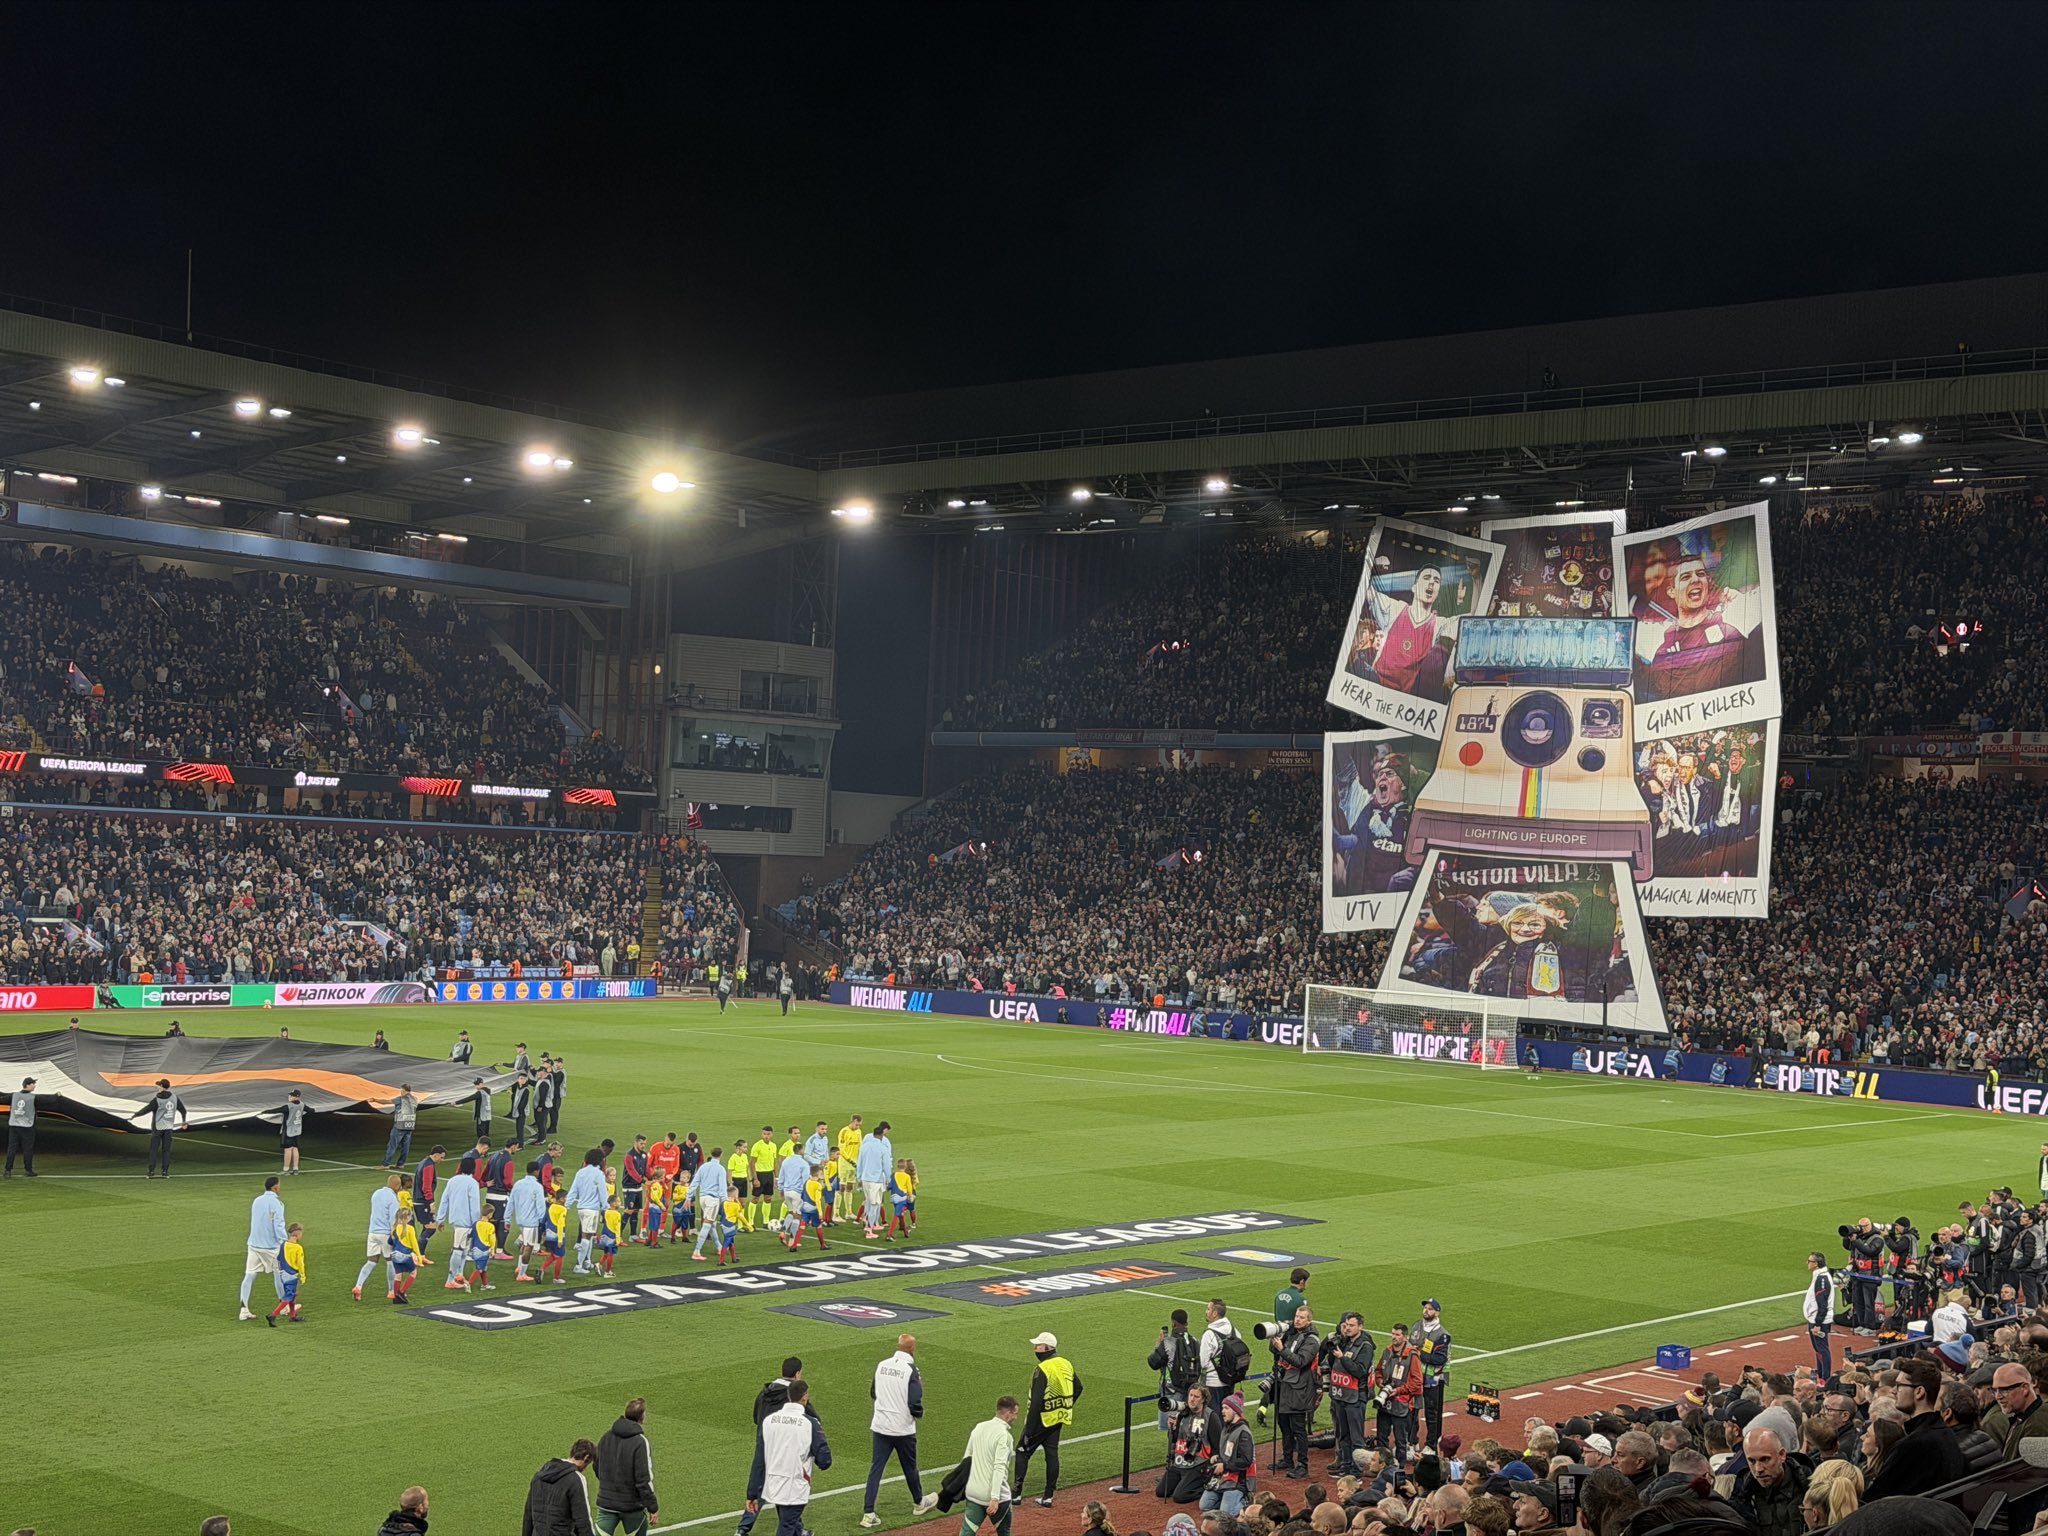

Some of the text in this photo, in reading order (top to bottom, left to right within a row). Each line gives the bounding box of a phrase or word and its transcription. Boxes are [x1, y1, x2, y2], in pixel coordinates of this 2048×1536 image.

[1544, 593, 1563, 607] NHS
[1341, 678, 1438, 733] HEAR THE ROAR
[1647, 686, 1756, 733] GIANT KILLERS
[1459, 716, 1494, 731] 1874
[1279, 750, 1308, 758] FOOTBALL
[1985, 744, 2048, 753] POLESWORTH
[40, 758, 145, 774] UEFA EUROPA LEAGUE
[306, 776, 340, 786] JUST EAT
[472, 785, 549, 798] UEFA EUROPA LEAGUE
[1465, 828, 1588, 845] LIGHTING UP EUROPE
[1452, 863, 1580, 886] ASTON VILLA
[1638, 885, 1758, 906] MAGICAL MOMENTS
[1347, 900, 1382, 922] UTV
[143, 988, 230, 1005] enterprise
[596, 981, 645, 997] #FOOTBALL
[851, 985, 933, 1013] WELCOME ALL
[989, 999, 1040, 1023] UEFA
[429, 1212, 1283, 1324] UEFA EUROPA LEAGUE
[979, 1265, 1177, 1297] #FOOTBALL
[880, 1366, 900, 1377] BOLOGNA
[771, 1416, 797, 1426] BOLOGNA
